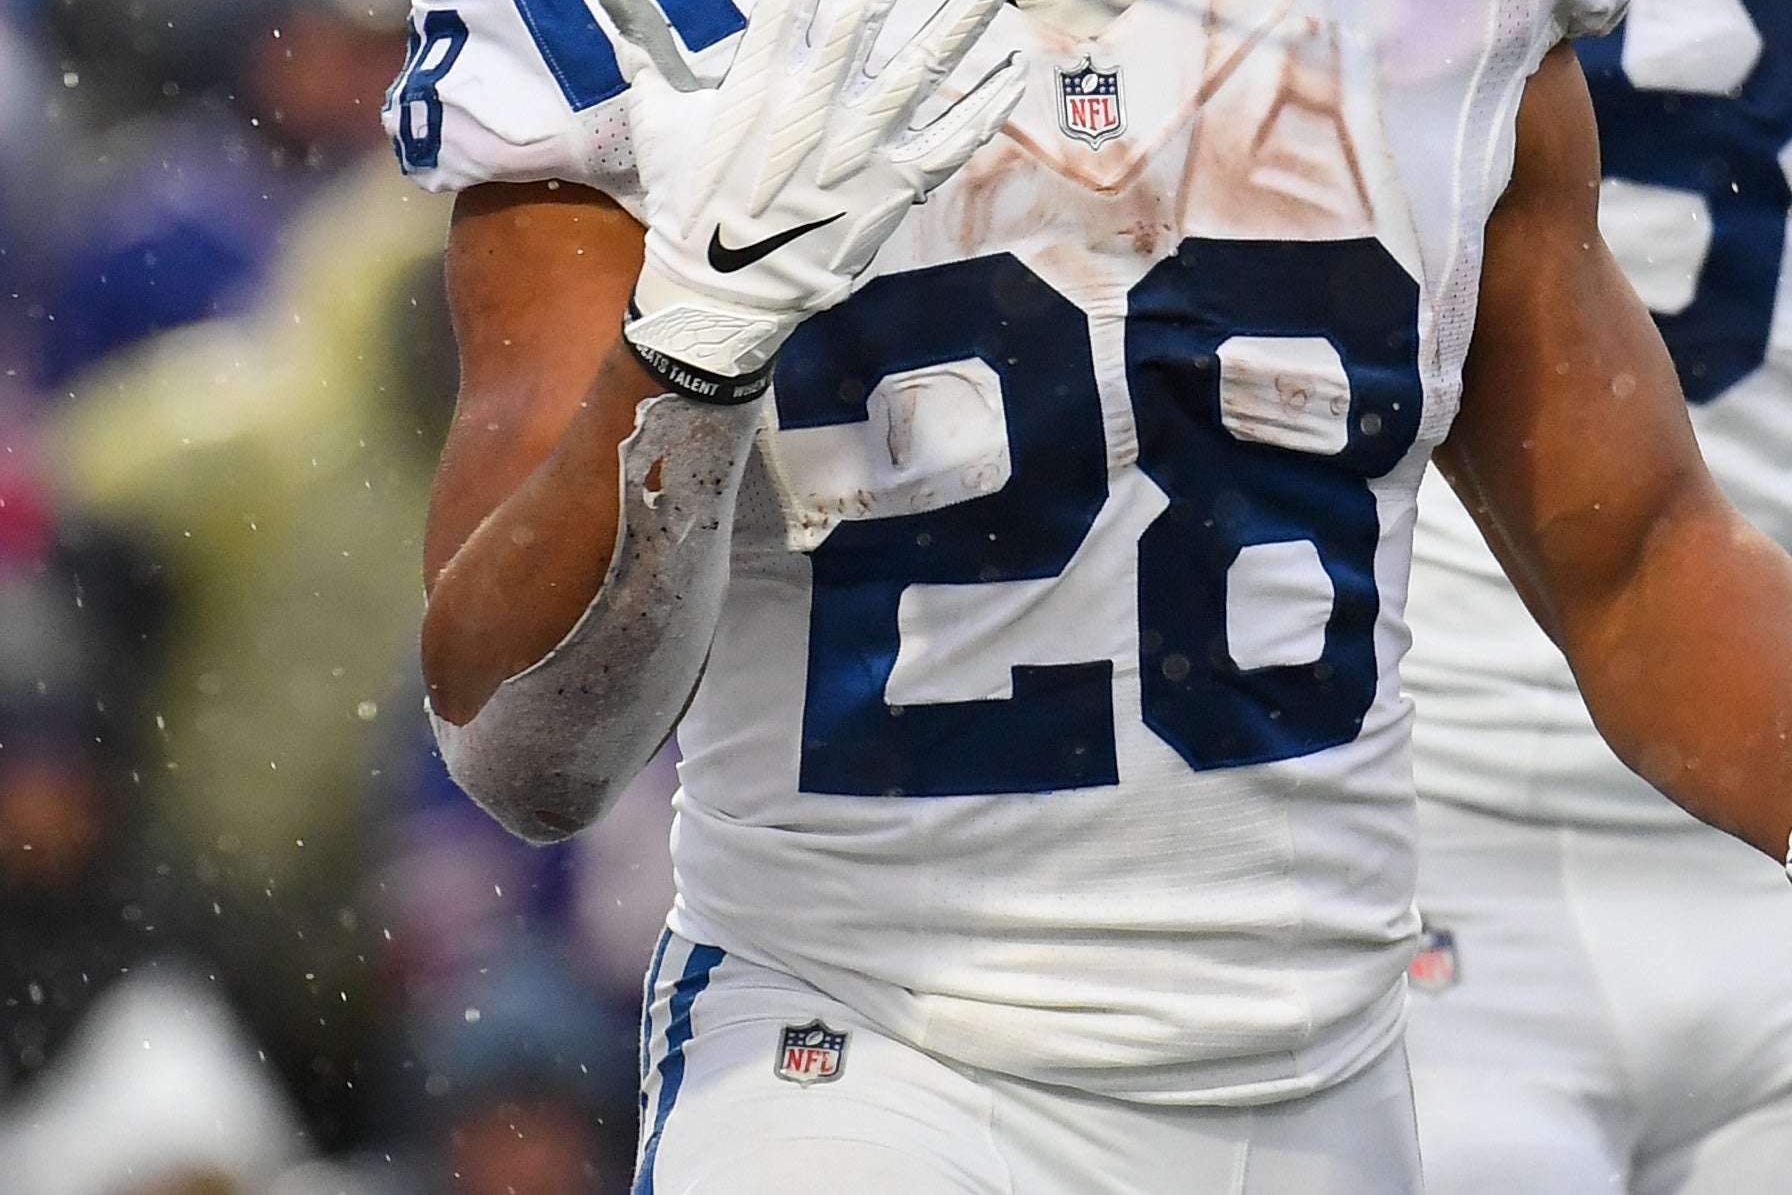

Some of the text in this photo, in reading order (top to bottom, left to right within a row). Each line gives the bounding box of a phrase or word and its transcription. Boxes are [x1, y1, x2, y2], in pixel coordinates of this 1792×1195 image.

[1069, 97, 1117, 132] NFL
[669, 365, 720, 398] TALENT
[773, 237, 1425, 798] 28
[786, 1048, 833, 1074] NFL
